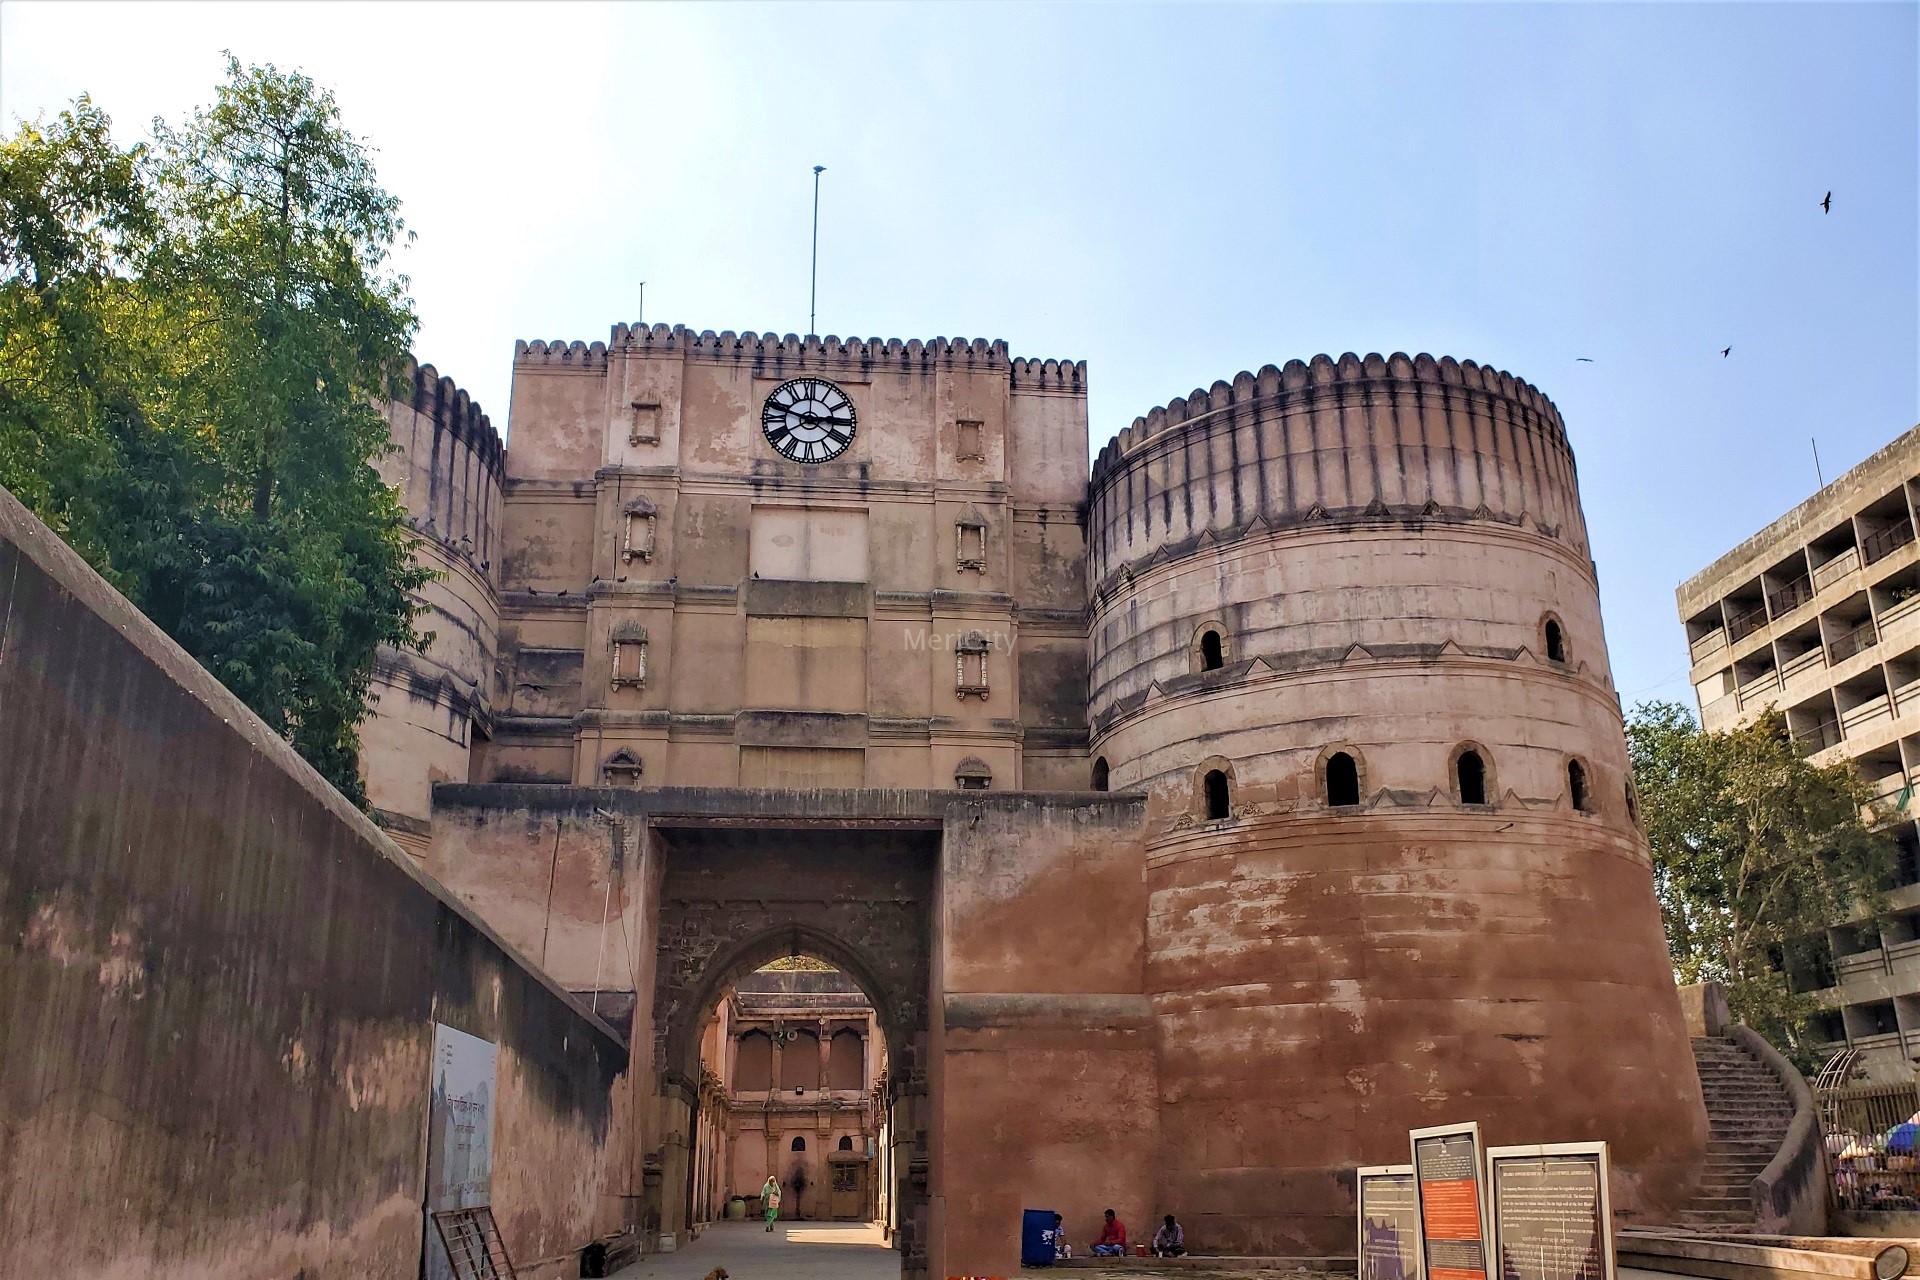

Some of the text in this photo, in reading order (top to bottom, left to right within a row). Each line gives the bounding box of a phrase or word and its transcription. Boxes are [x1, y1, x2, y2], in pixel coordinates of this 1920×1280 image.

[804, 382, 816, 400] XII
[829, 401, 848, 412] II
[766, 414, 786, 422] IX
